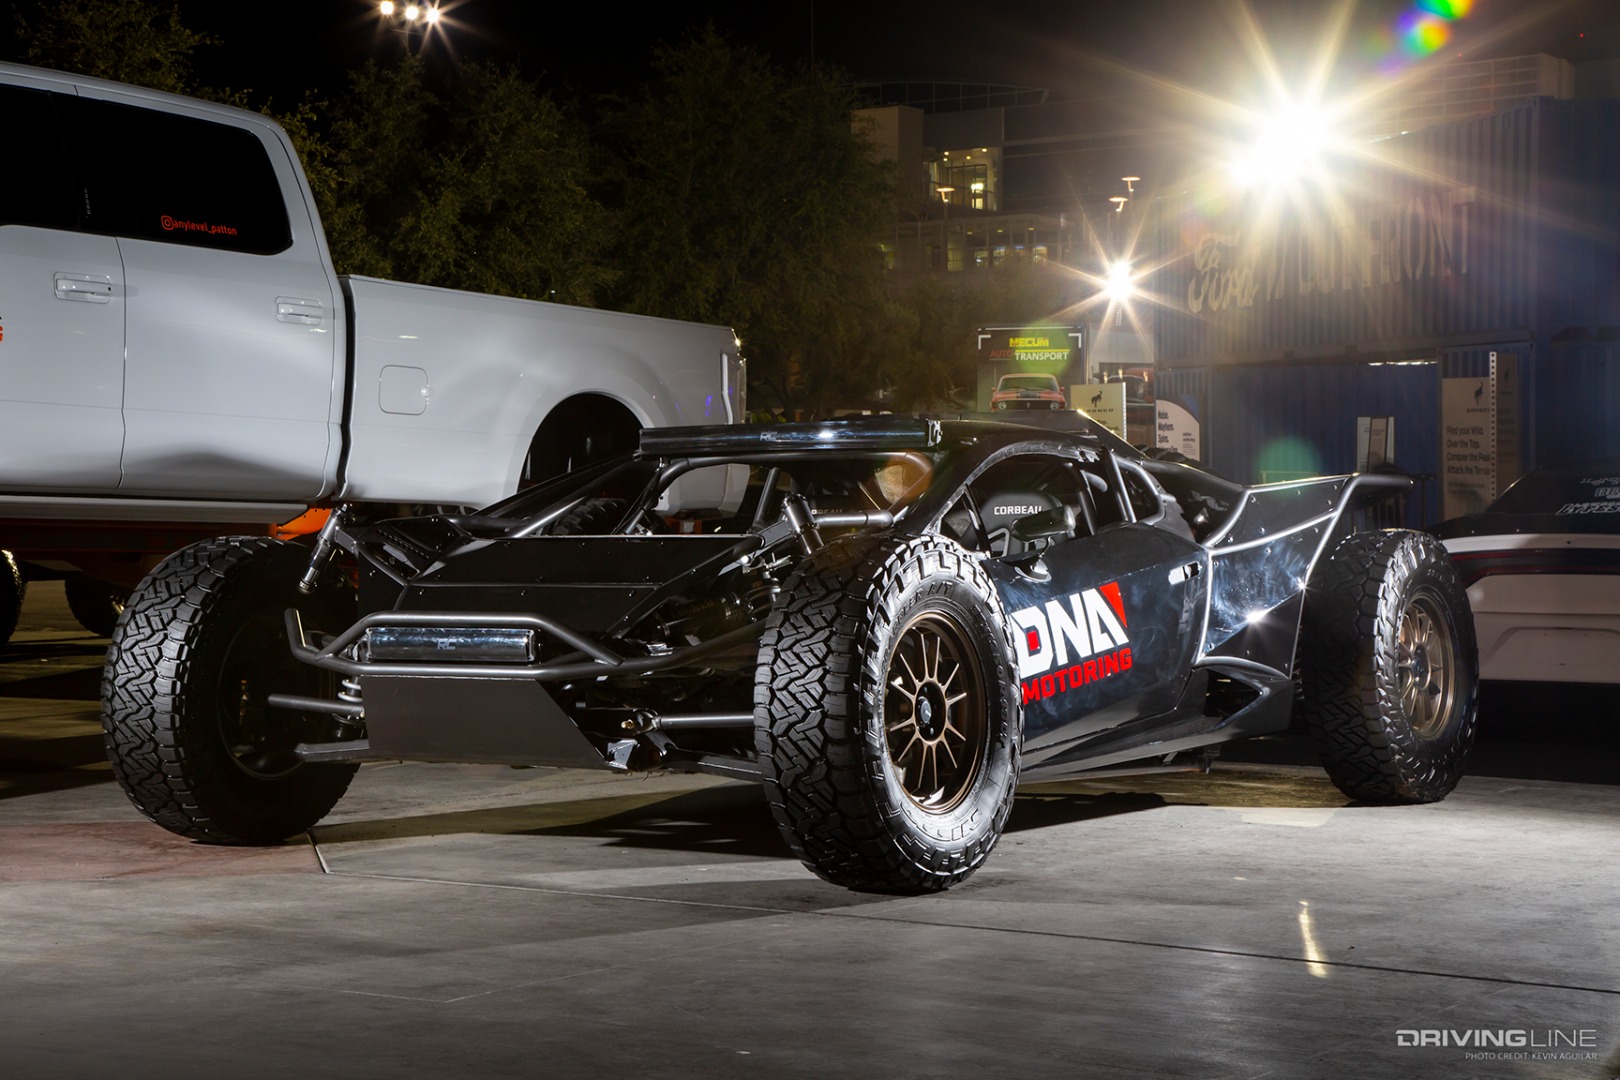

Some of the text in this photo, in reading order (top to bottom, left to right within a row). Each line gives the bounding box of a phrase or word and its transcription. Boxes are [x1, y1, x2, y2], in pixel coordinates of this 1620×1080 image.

[173, 220, 238, 236] anylevel_patton
[1009, 338, 1049, 348] MECUM
[990, 350, 1069, 361] AUTO TRANSPORT
[1009, 581, 1130, 680] DNA
[1021, 647, 1133, 705] MOTORING
